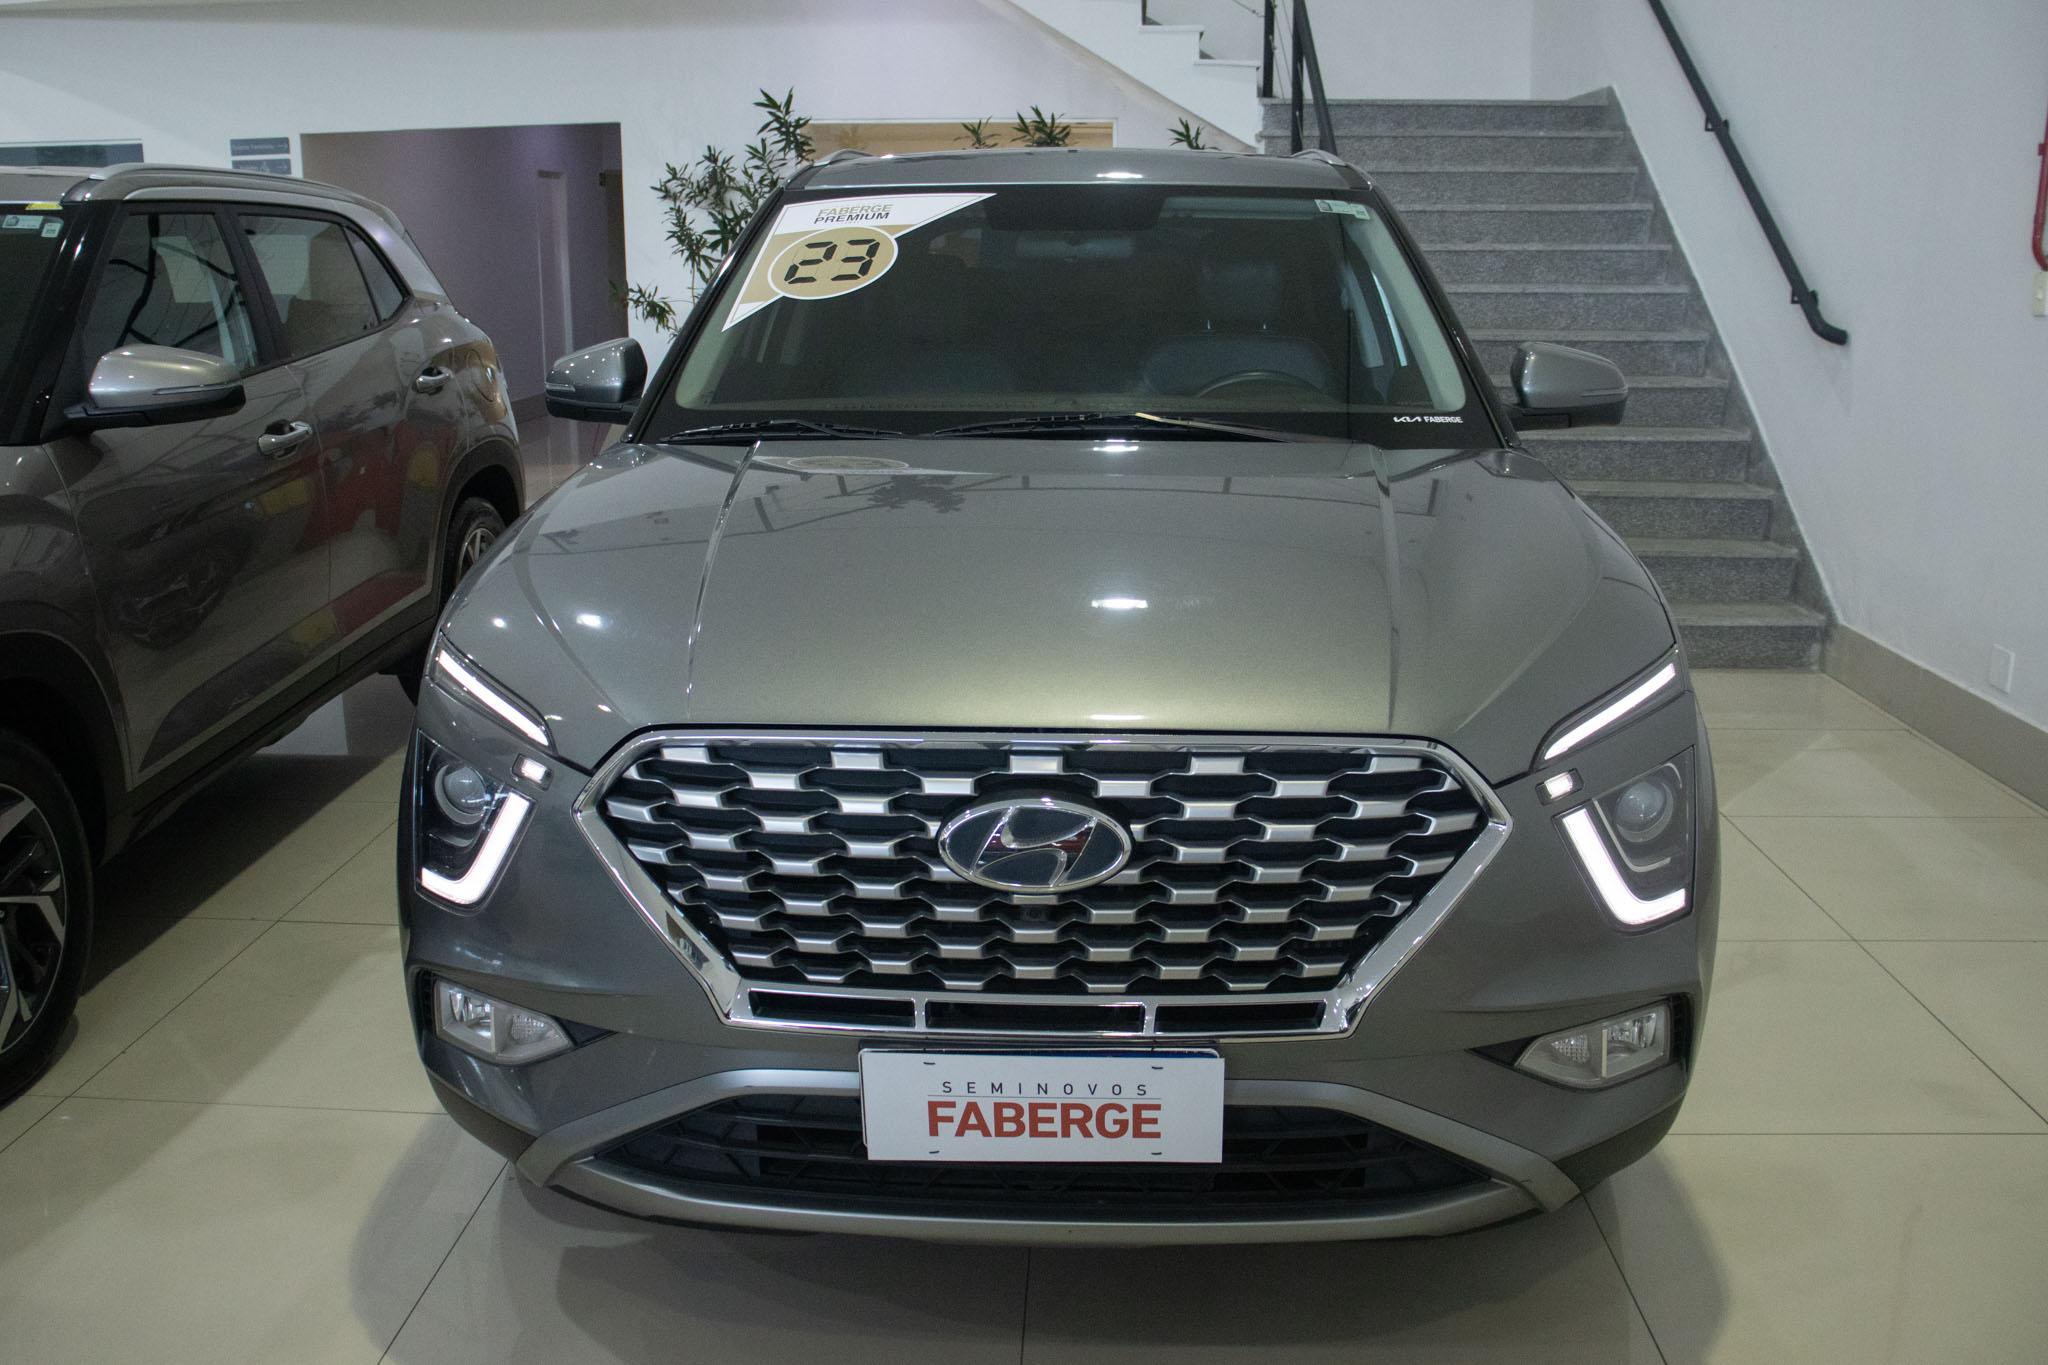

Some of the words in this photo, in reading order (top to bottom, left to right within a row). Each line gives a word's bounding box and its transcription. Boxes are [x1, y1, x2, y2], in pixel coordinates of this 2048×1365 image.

[818, 204, 893, 216] FABERGE
[814, 212, 890, 224] PREMIUM
[784, 238, 881, 285] 23
[1423, 416, 1463, 424] FABERGE
[942, 1081, 1147, 1096] SEMINOVOS
[927, 1100, 1162, 1139] FABERGE
